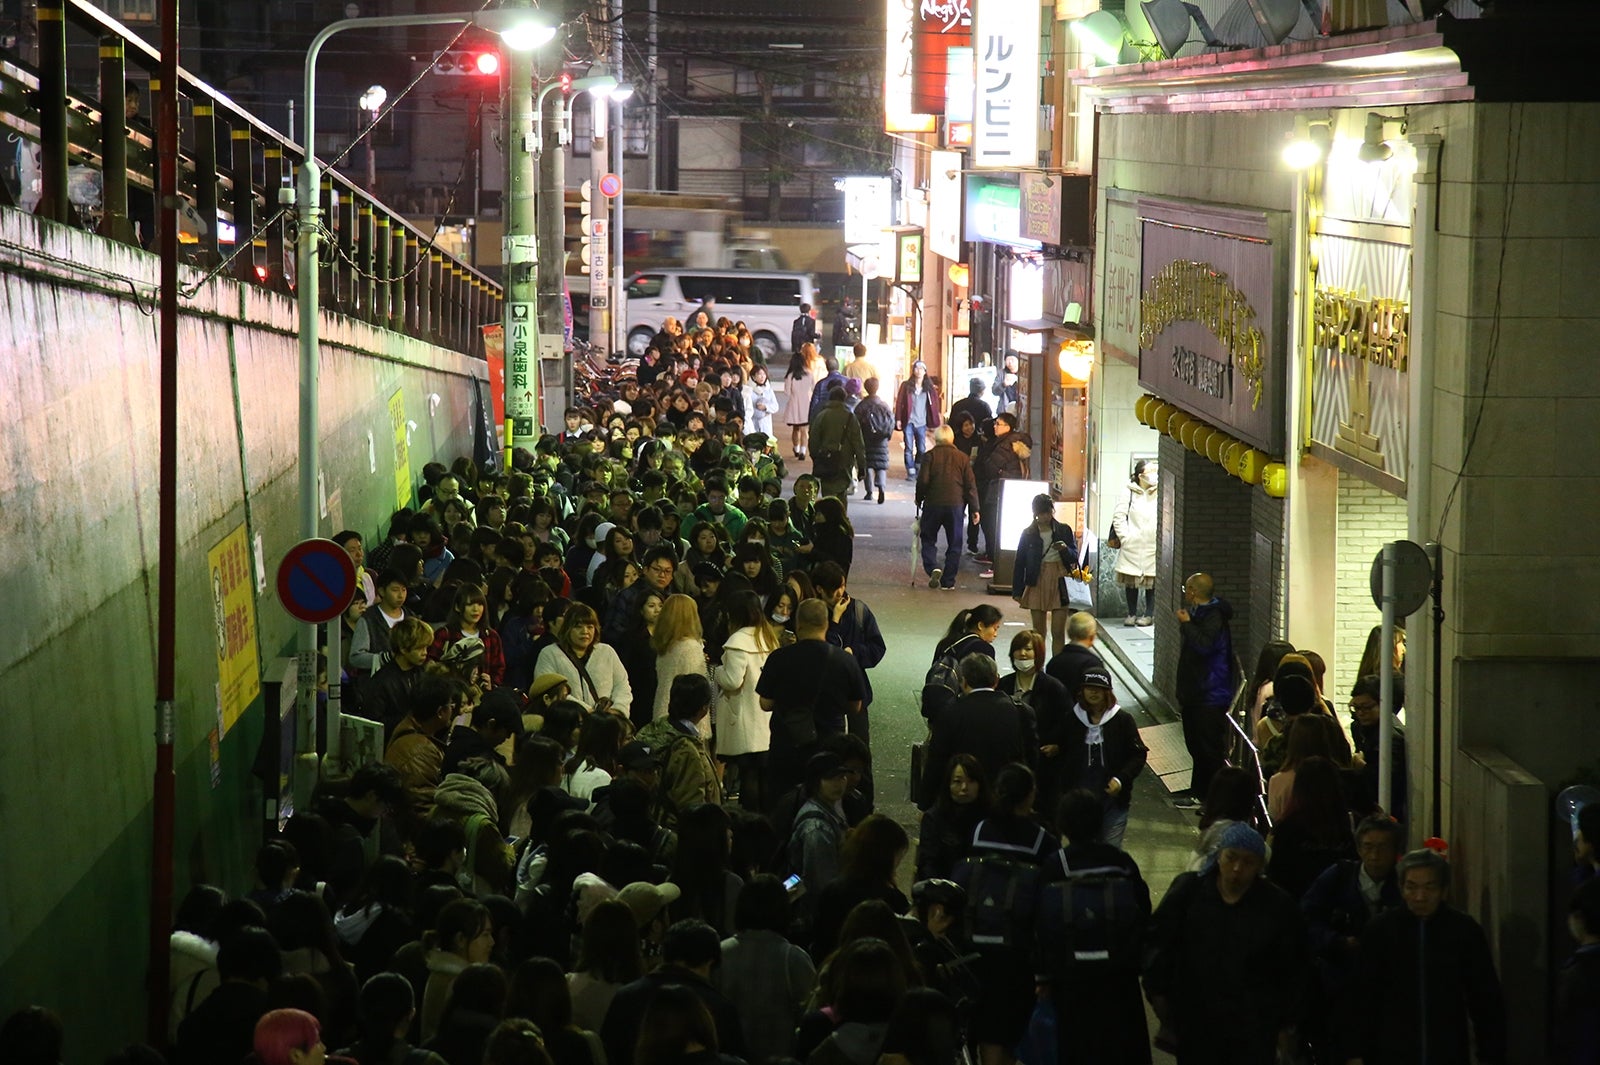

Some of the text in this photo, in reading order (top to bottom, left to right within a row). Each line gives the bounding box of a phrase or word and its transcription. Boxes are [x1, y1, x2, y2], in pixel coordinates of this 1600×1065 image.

[983, 35, 1014, 155] ルンビニー
[513, 324, 528, 389] 小泉歯科
